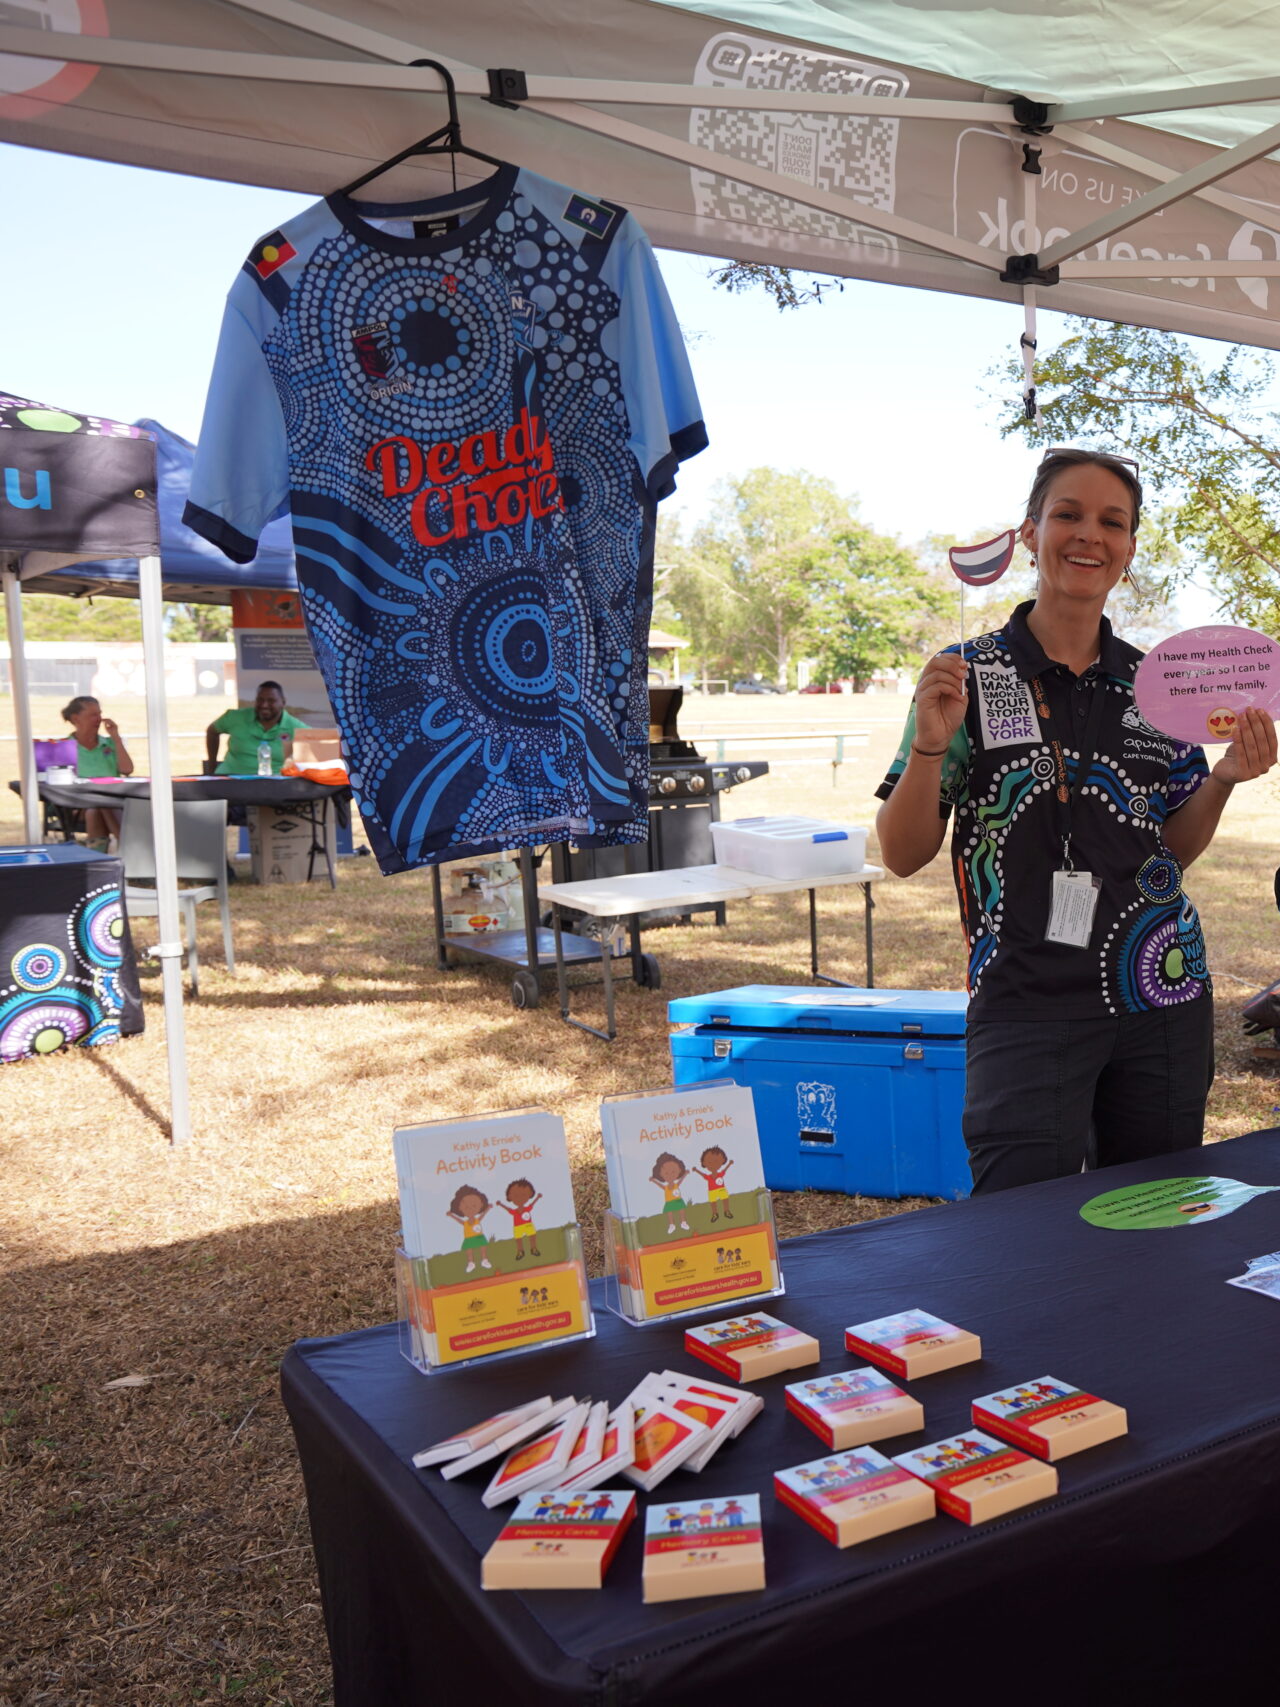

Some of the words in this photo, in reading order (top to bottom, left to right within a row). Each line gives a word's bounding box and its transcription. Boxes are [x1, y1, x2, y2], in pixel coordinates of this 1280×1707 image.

[354, 321, 387, 337] AMPOL
[369, 381, 412, 400] ORIGIN
[1157, 653, 1162, 662] I
[1164, 651, 1188, 662] have
[1190, 650, 1206, 661] my
[1208, 647, 1241, 659] Health
[1243, 644, 1273, 656] Check
[979, 670, 1020, 682] DON'T
[1163, 669, 1191, 680] every
[1193, 667, 1215, 679] year
[1218, 666, 1230, 674] so
[1238, 664, 1256, 673] can
[1257, 662, 1271, 671] be
[980, 680, 1026, 692] MAKE
[983, 689, 1028, 699] SMOKES
[1169, 685, 1197, 697] there
[1200, 684, 1214, 694] for
[1216, 684, 1232, 694] my
[1234, 679, 1268, 692] family.
[984, 697, 1029, 710] YOUR
[986, 707, 1030, 718] STORY
[987, 716, 1034, 730] CAPE
[989, 727, 1035, 741] YORK
[1122, 752, 1140, 760] CAPE
[1140, 753, 1156, 762] YORK
[653, 1111, 678, 1123] Kathy
[679, 1109, 686, 1117] &
[687, 1104, 714, 1117] Ernie's
[639, 1125, 692, 1143] Activity
[695, 1115, 734, 1133] Book
[453, 1139, 481, 1153] Kathy
[483, 1138, 490, 1147] &
[491, 1133, 522, 1147] Ernie's
[435, 1155, 497, 1175] Activity
[500, 1144, 542, 1165] Book
[514, 1528, 562, 1538] Memory
[566, 1527, 600, 1537] Cards
[660, 1538, 709, 1550] Memory
[711, 1532, 748, 1544] Cards
